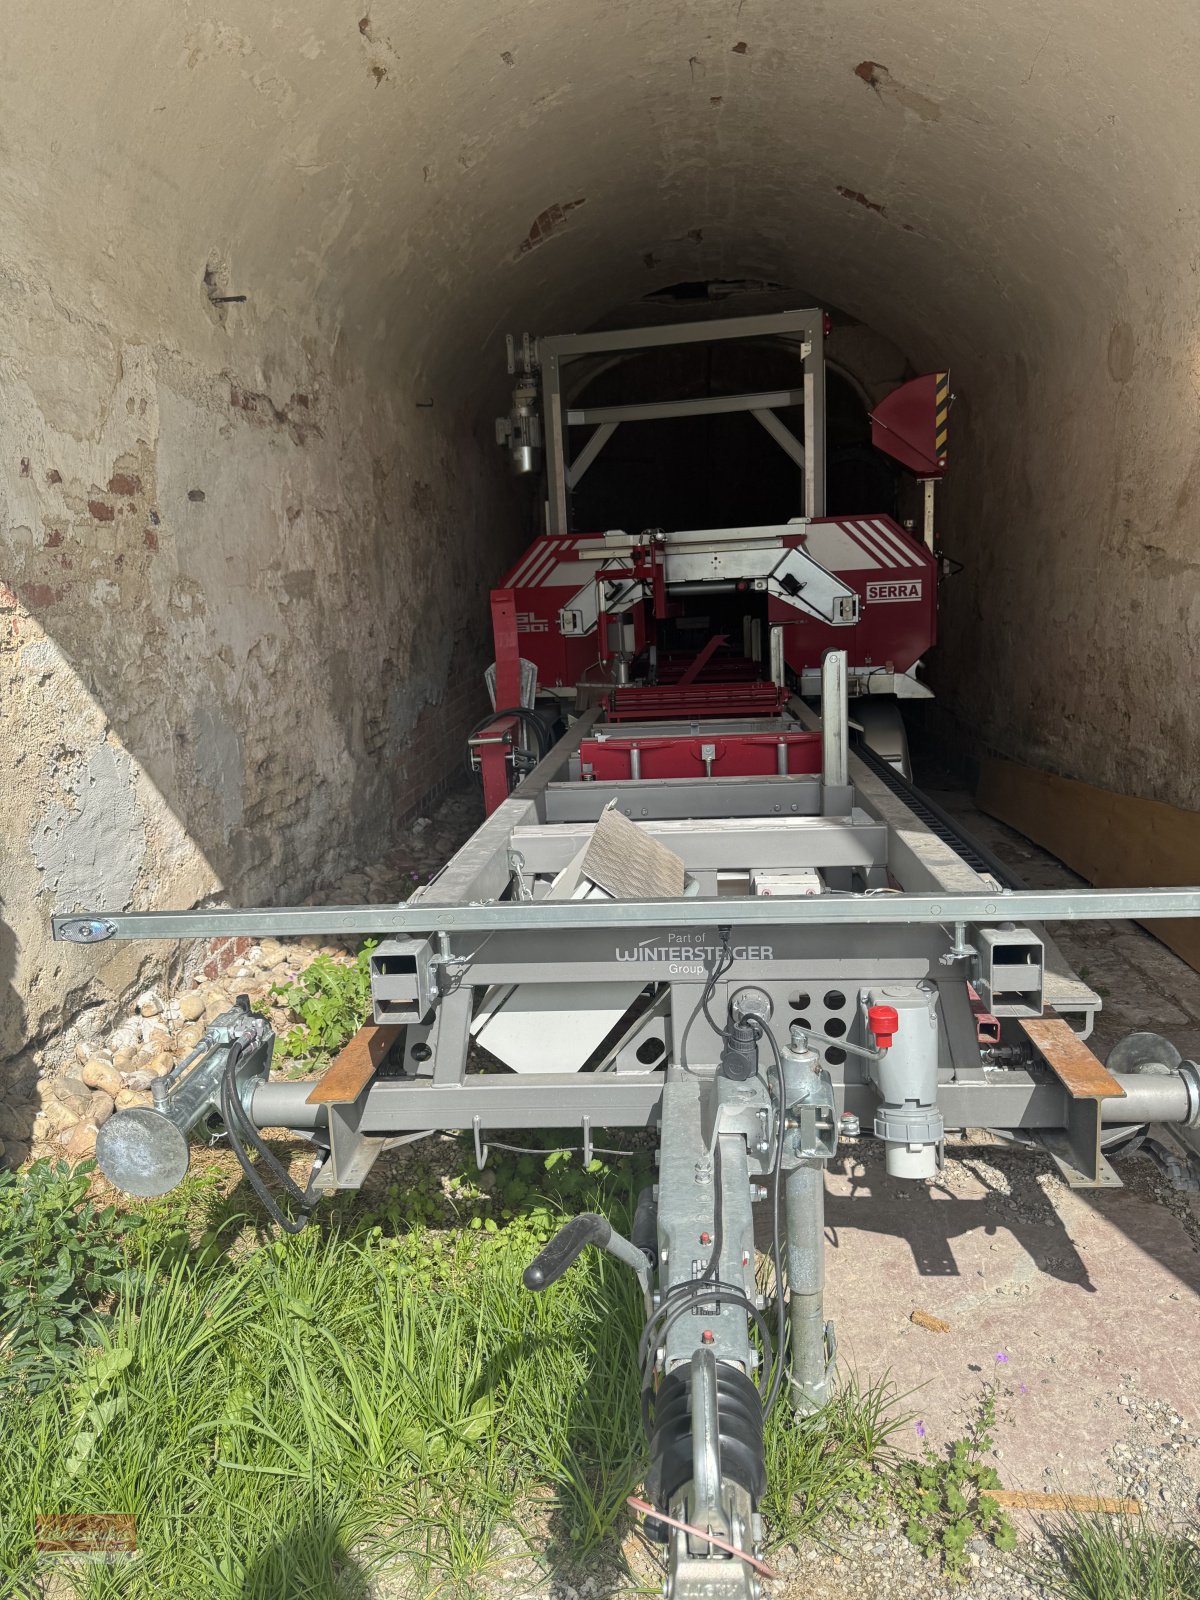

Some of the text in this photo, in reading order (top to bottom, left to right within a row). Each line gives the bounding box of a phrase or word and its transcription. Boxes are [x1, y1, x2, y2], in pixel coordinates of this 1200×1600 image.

[868, 585, 919, 599] SERRA
[668, 932, 706, 943] Part of
[668, 963, 704, 975] Group
